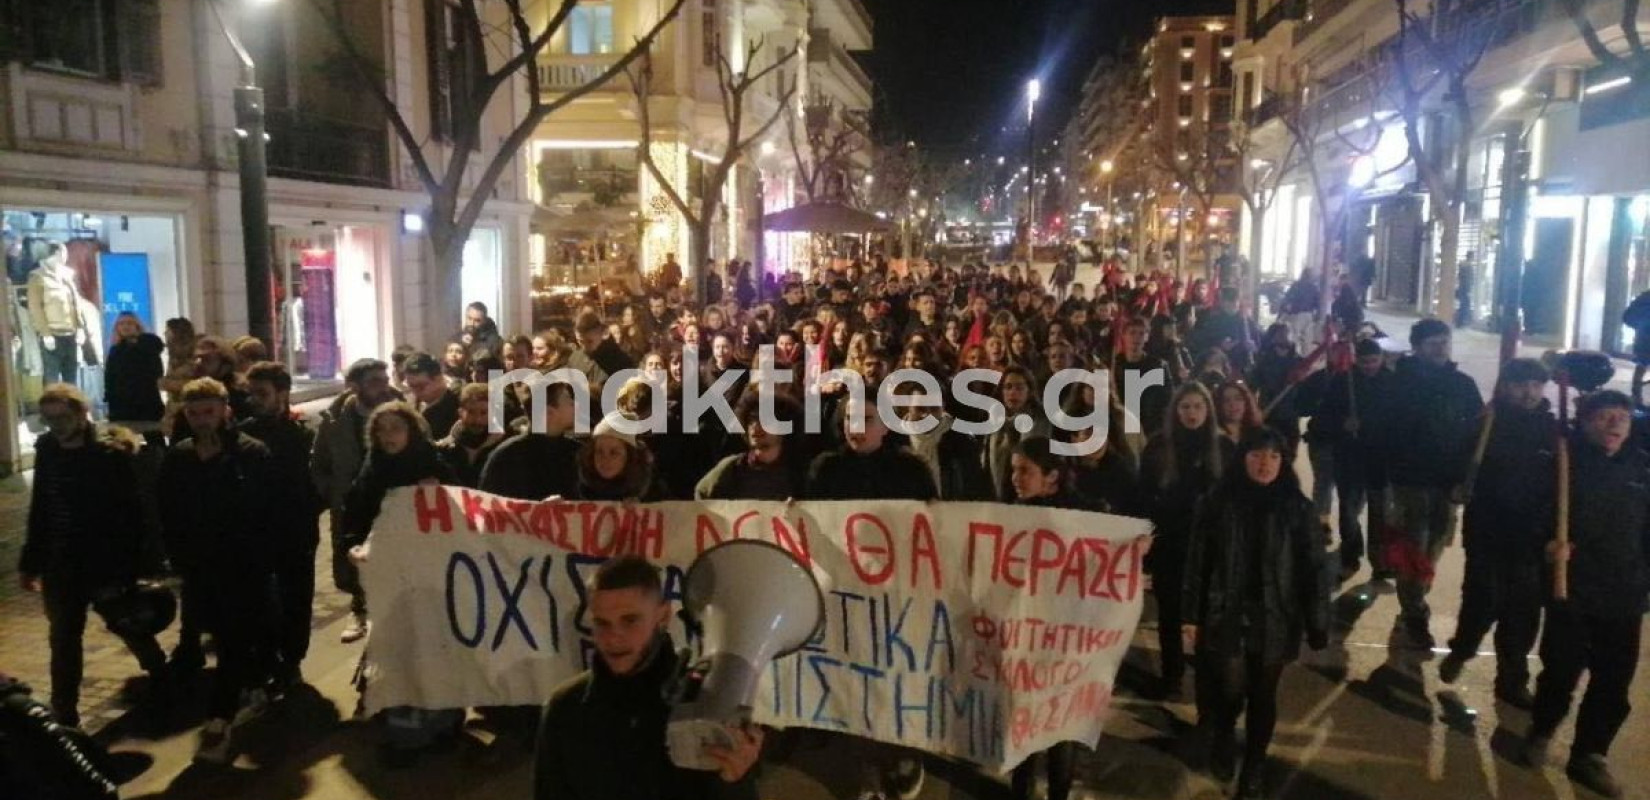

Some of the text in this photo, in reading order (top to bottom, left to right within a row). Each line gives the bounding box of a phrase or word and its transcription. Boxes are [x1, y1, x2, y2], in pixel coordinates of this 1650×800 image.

[414, 484, 453, 534] Η
[461, 489, 664, 559] ΚΑΤΑΣΤΟΛΗ
[845, 513, 942, 589] ΘΑ
[967, 521, 1146, 603] ΠΕΡΑΣΕΙ
[446, 551, 560, 653] ΟΧΙ
